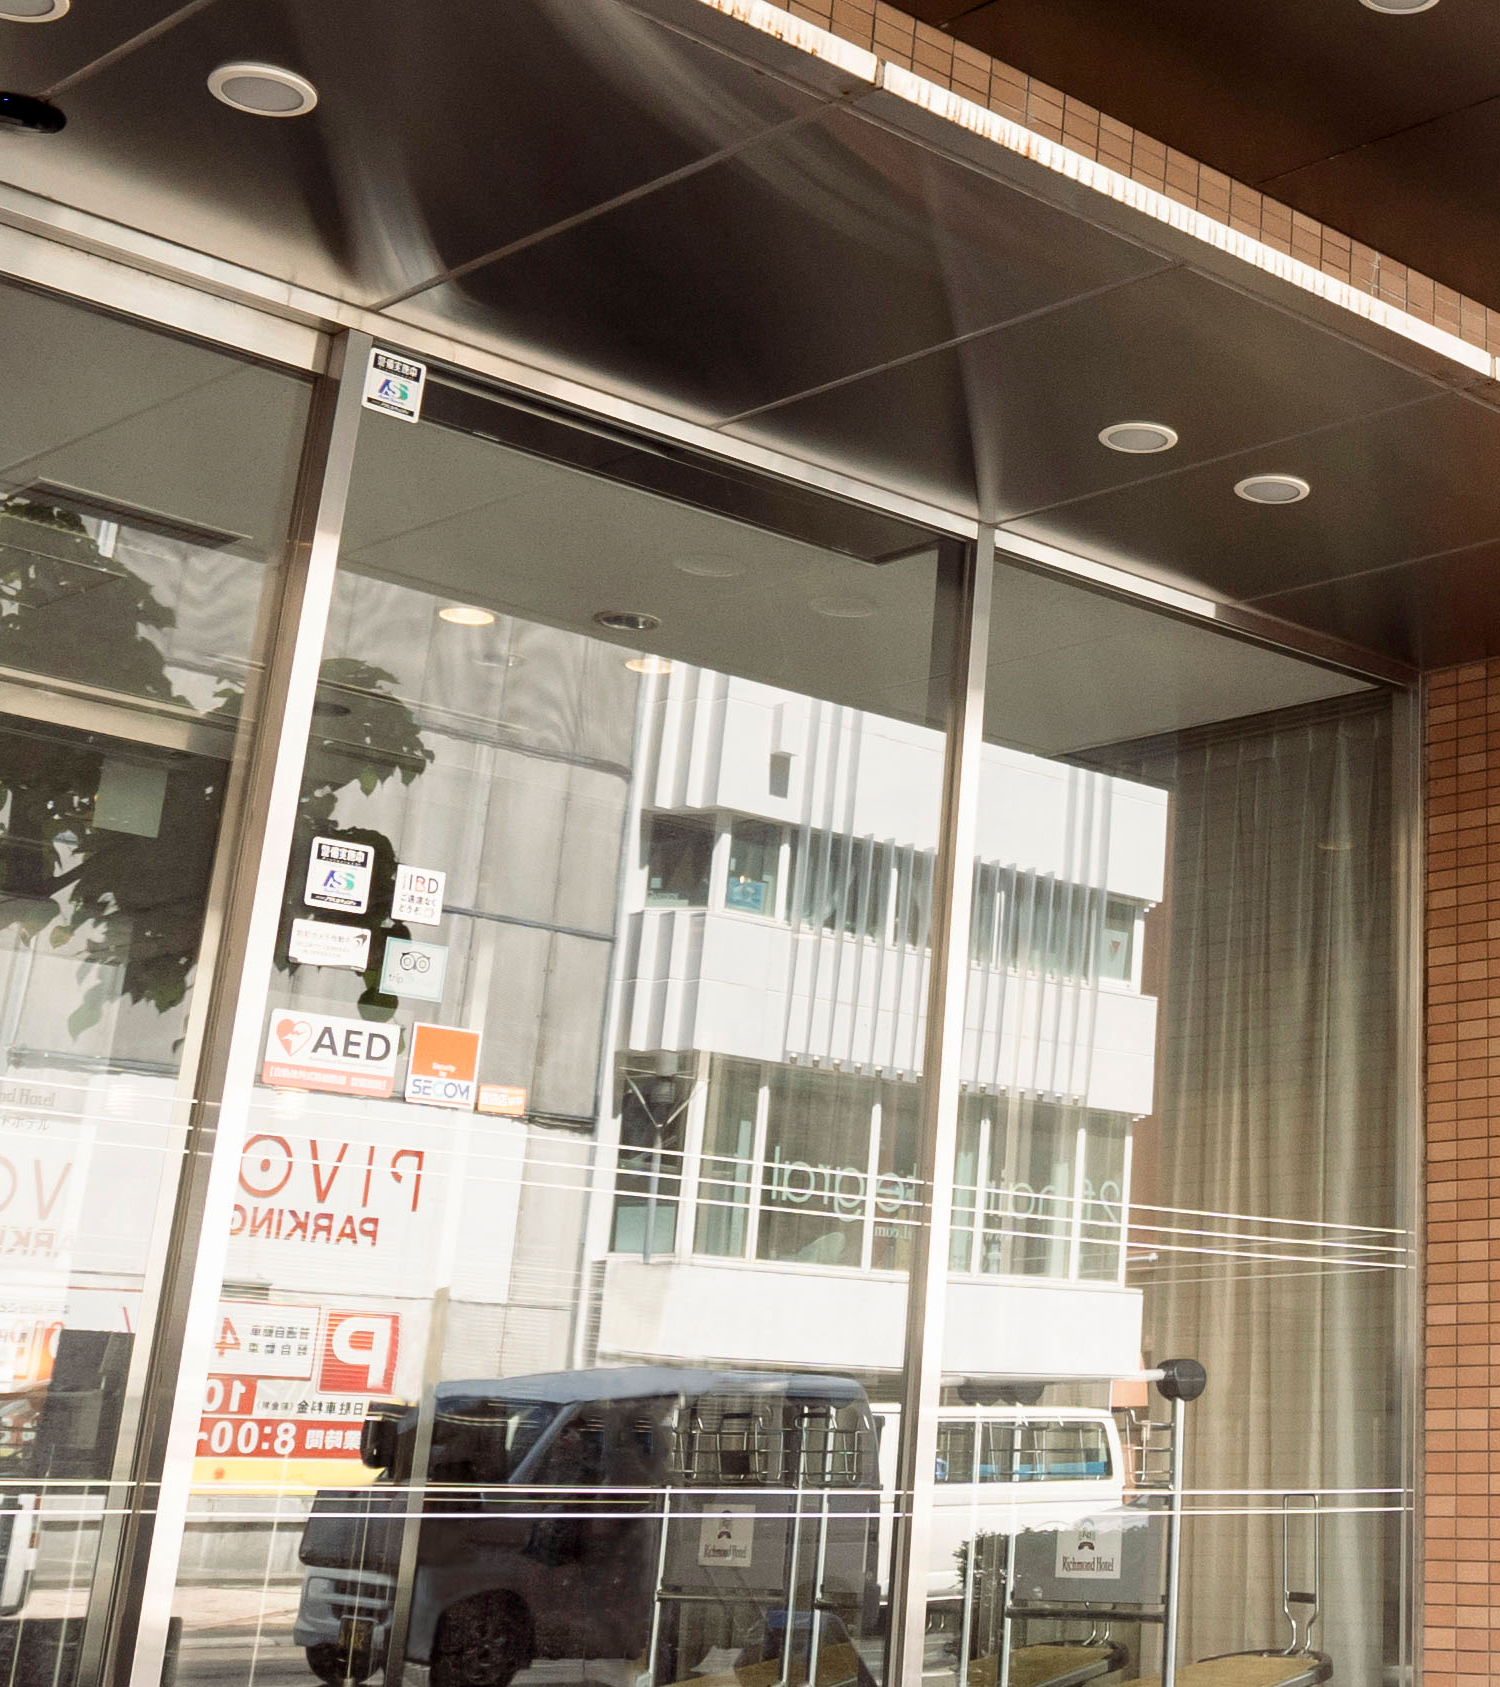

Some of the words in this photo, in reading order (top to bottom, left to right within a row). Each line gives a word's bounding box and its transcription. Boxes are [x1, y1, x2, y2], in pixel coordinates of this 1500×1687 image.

[311, 1026, 391, 1061] AED
[411, 1078, 470, 1100] SECOM
[1062, 1555, 1095, 1574] Richmond
[1096, 1555, 1114, 1573] Hotel
